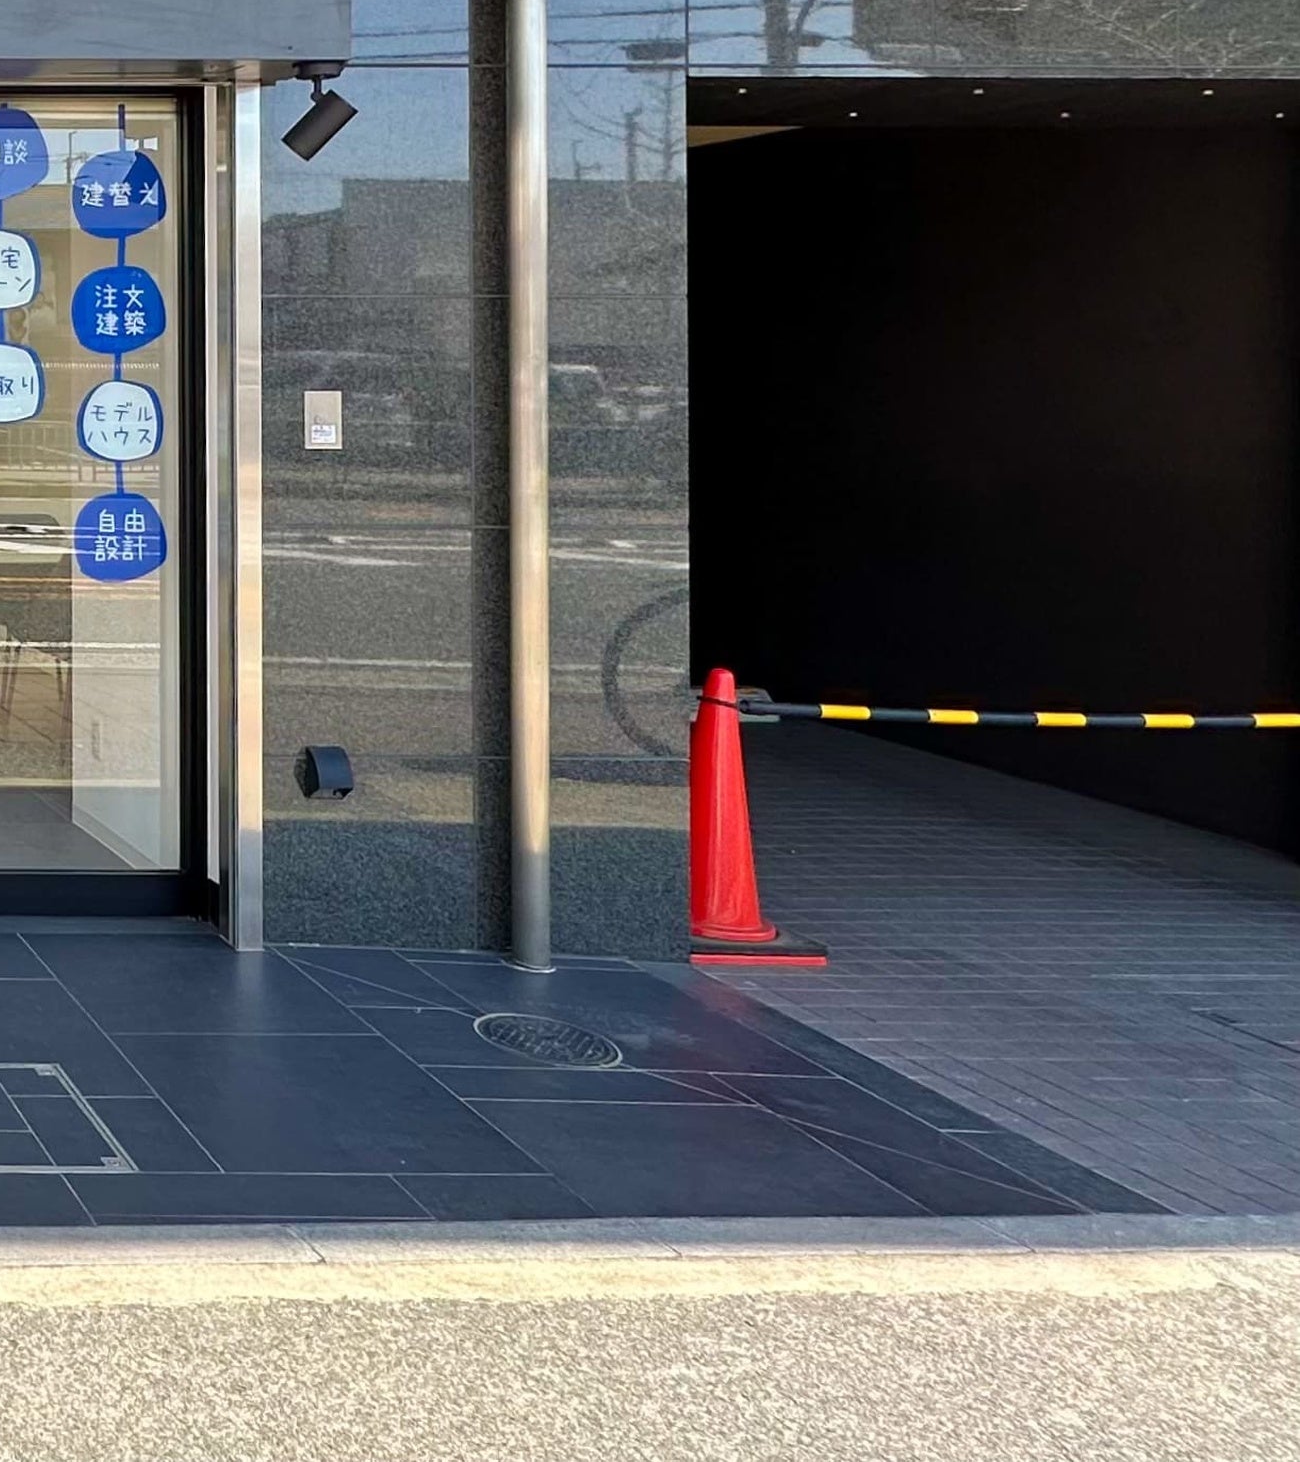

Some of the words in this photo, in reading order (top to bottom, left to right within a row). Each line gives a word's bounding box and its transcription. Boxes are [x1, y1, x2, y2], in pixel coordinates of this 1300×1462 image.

[81, 180, 159, 207] 建替え
[95, 284, 145, 309] 注文
[96, 310, 147, 336] 建築
[90, 400, 155, 422] モデル
[87, 427, 152, 446] ハウス
[98, 508, 146, 533] 自由
[94, 538, 148, 562] 設計
